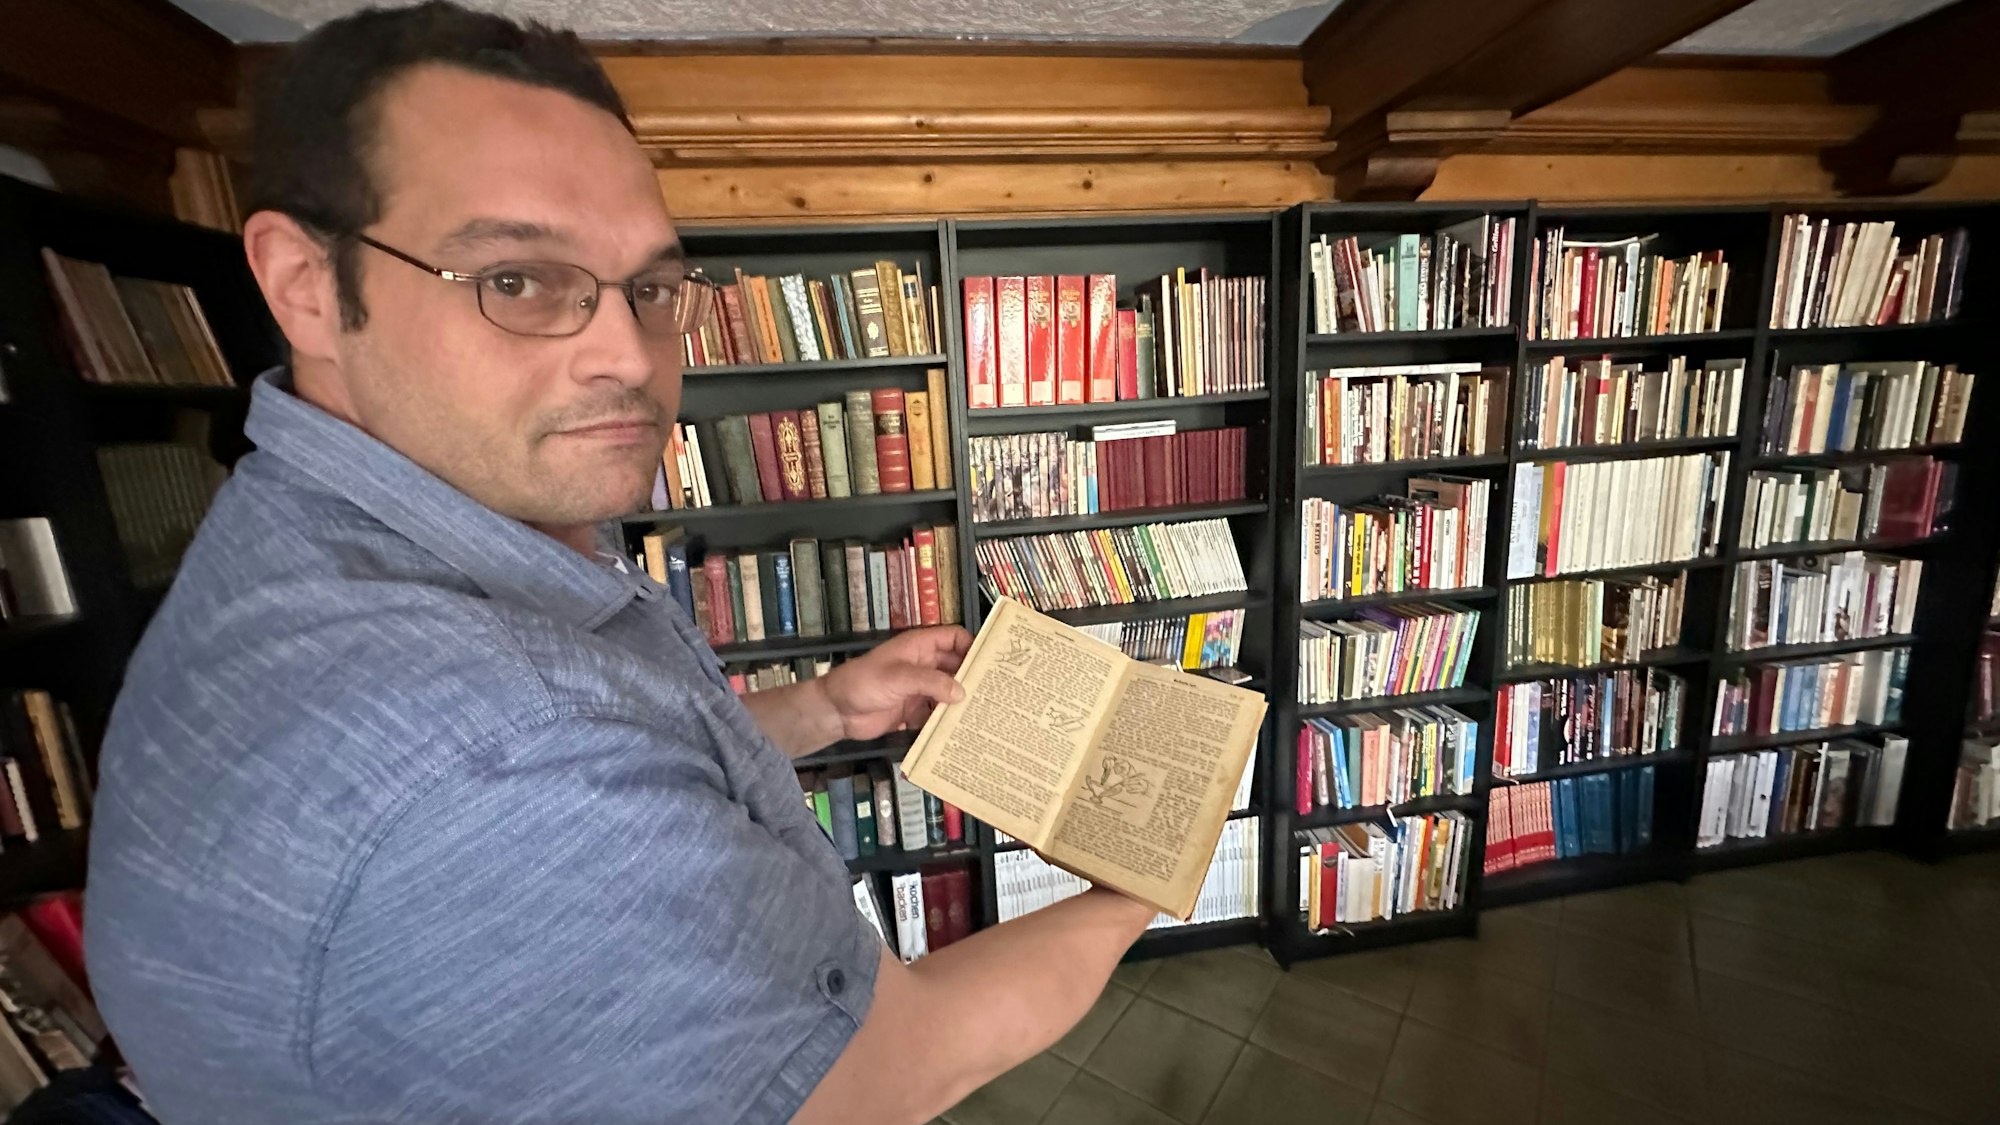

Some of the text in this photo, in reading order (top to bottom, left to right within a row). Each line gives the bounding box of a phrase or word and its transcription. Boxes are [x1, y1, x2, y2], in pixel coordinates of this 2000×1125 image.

[1491, 223, 1500, 252] Grillen
[1313, 522, 1321, 555] GRILLEN
[909, 885, 920, 919] kochen
